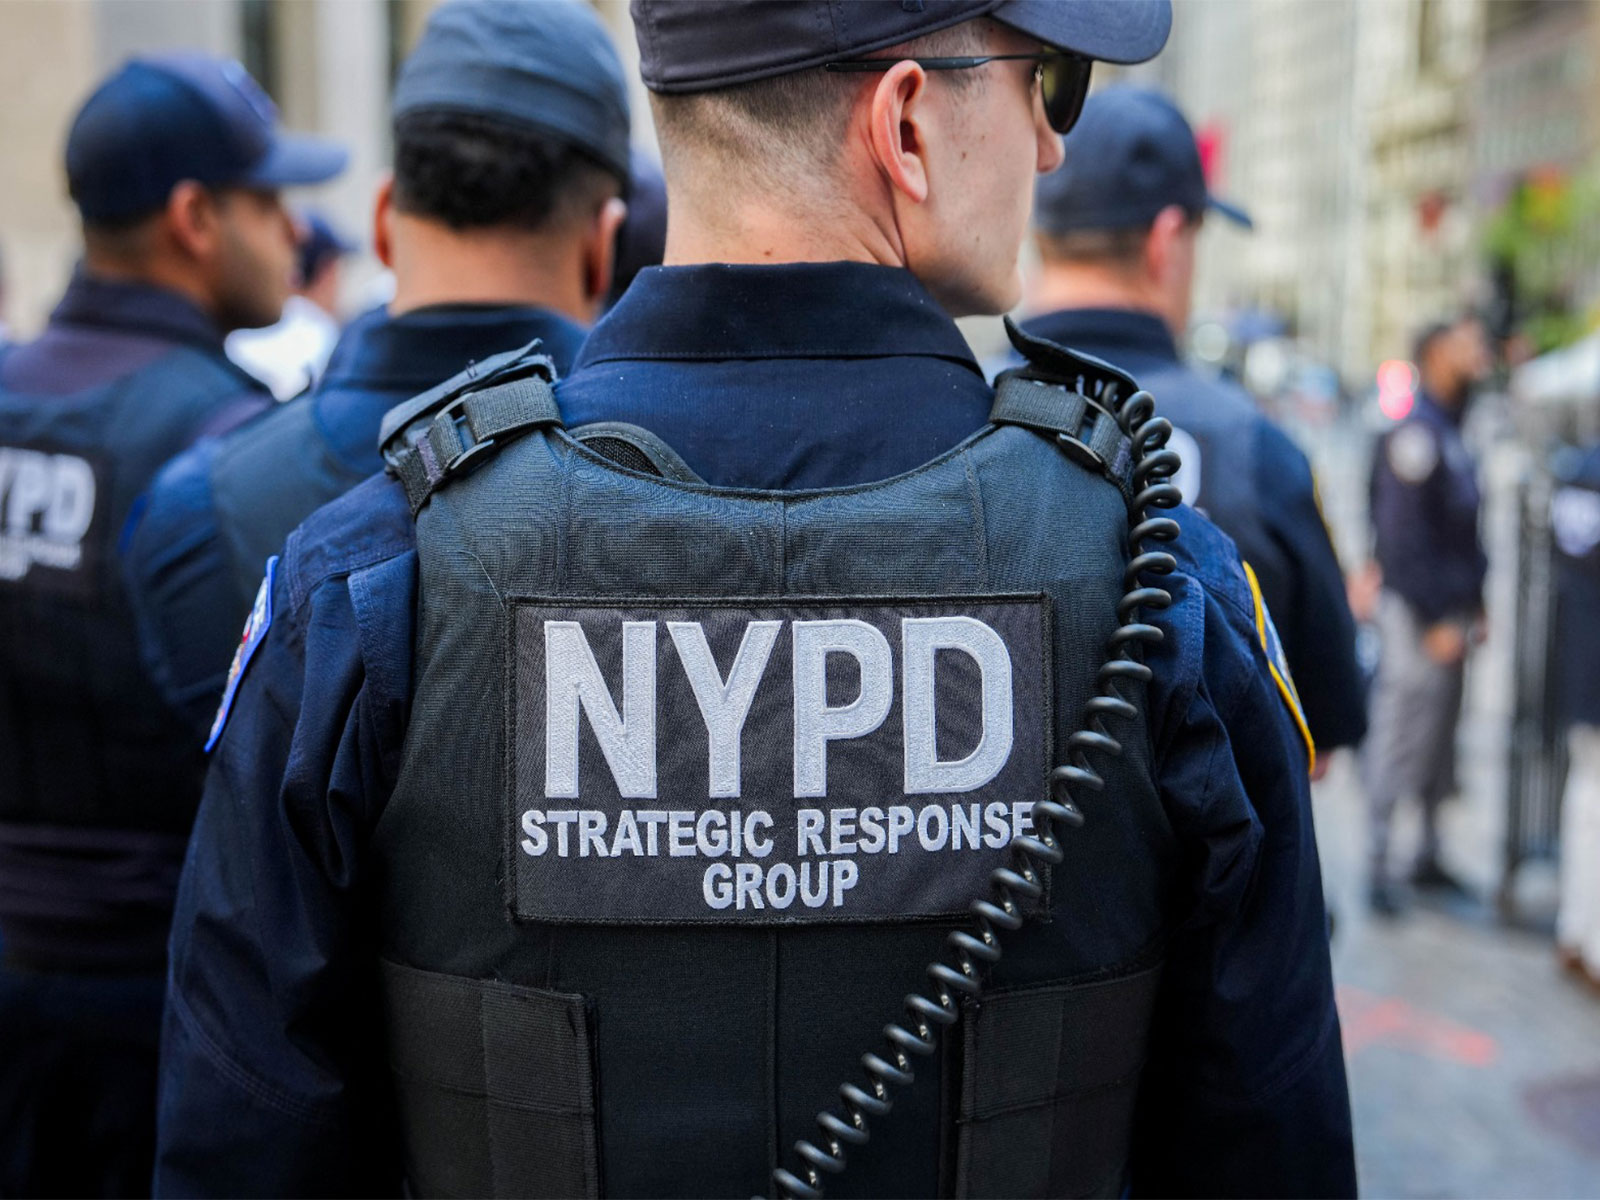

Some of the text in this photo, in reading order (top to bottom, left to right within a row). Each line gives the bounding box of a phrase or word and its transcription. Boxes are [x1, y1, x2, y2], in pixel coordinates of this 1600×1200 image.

[544, 616, 1013, 799] NYPD
[521, 801, 1040, 857] STRATEGIC RESPONSE
[702, 859, 859, 910] GROUP
